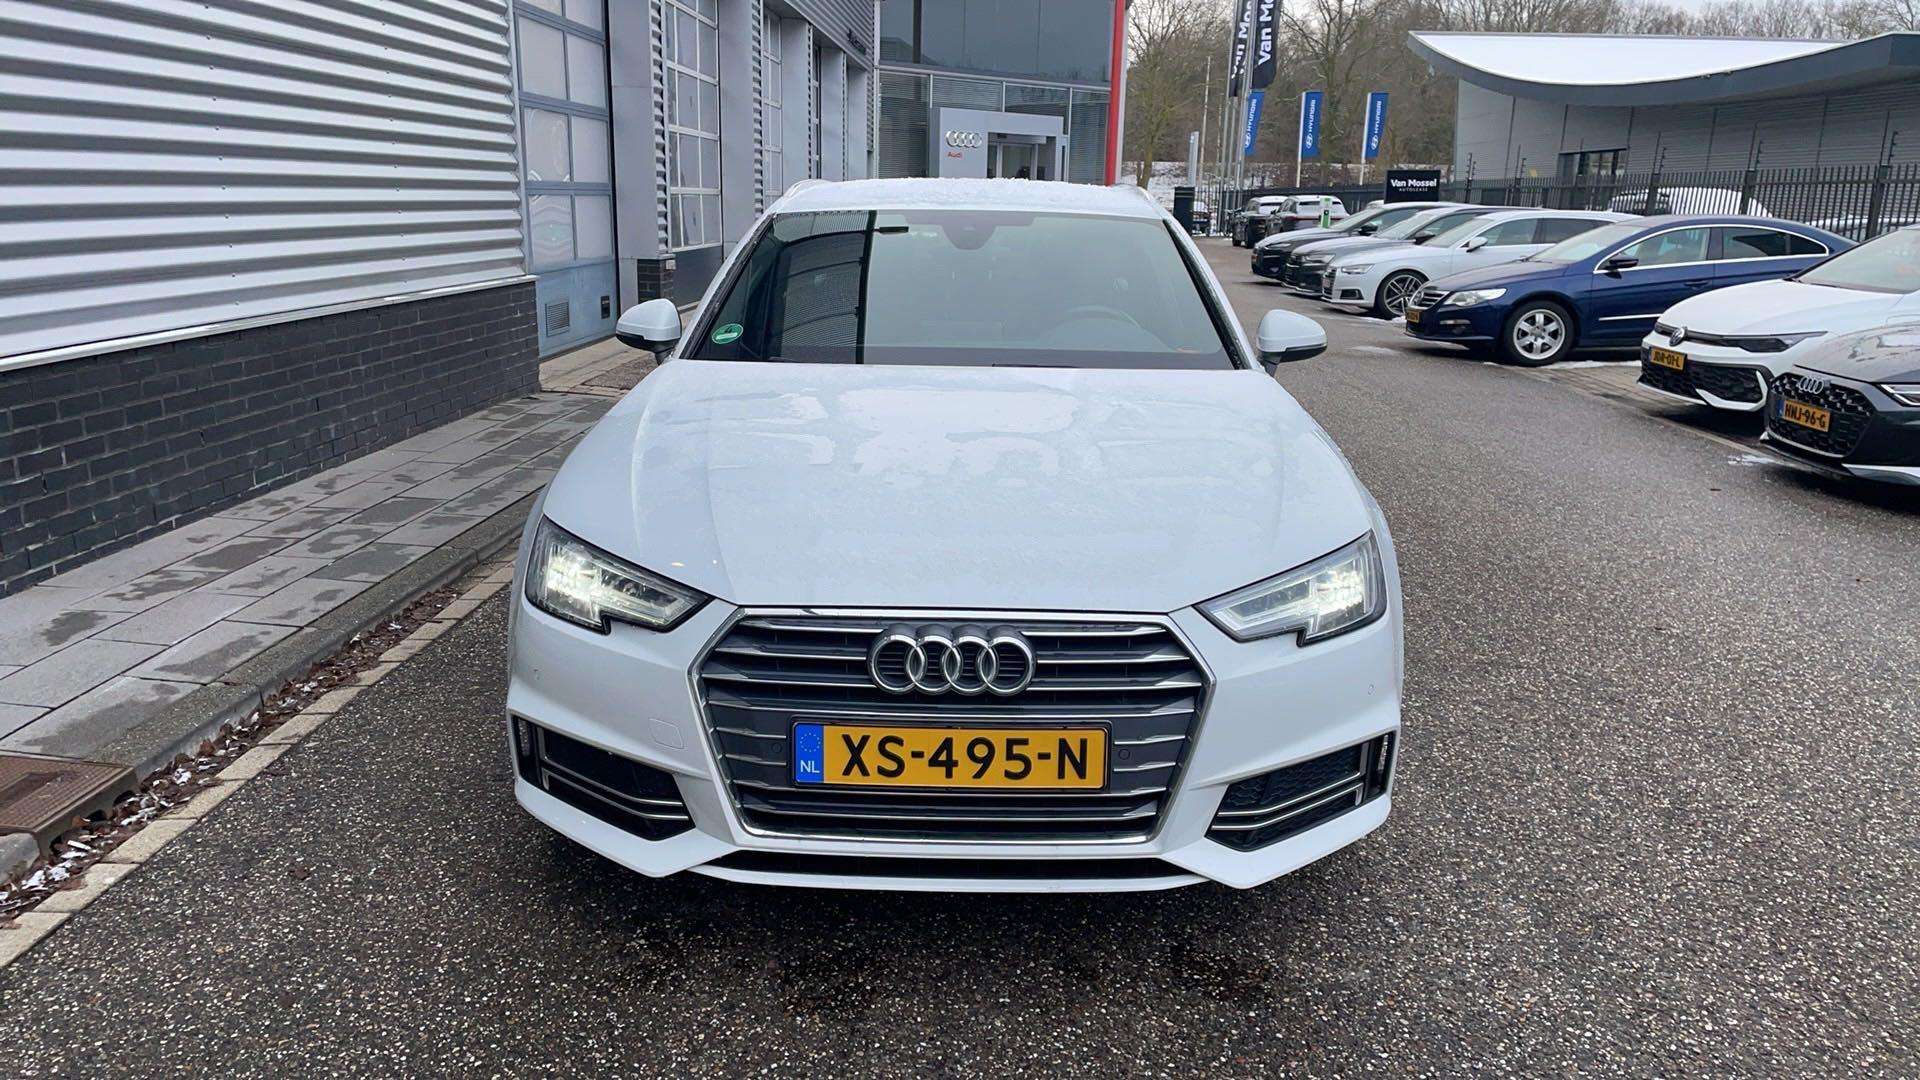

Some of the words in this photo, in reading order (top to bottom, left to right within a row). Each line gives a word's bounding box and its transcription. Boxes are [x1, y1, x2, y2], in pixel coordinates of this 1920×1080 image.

[1258, 28, 1272, 66] Van
[1390, 179, 1407, 187] Van
[1408, 178, 1437, 187] Mossel
[800, 760, 820, 773] NL
[842, 734, 1088, 780] XS-495-N
